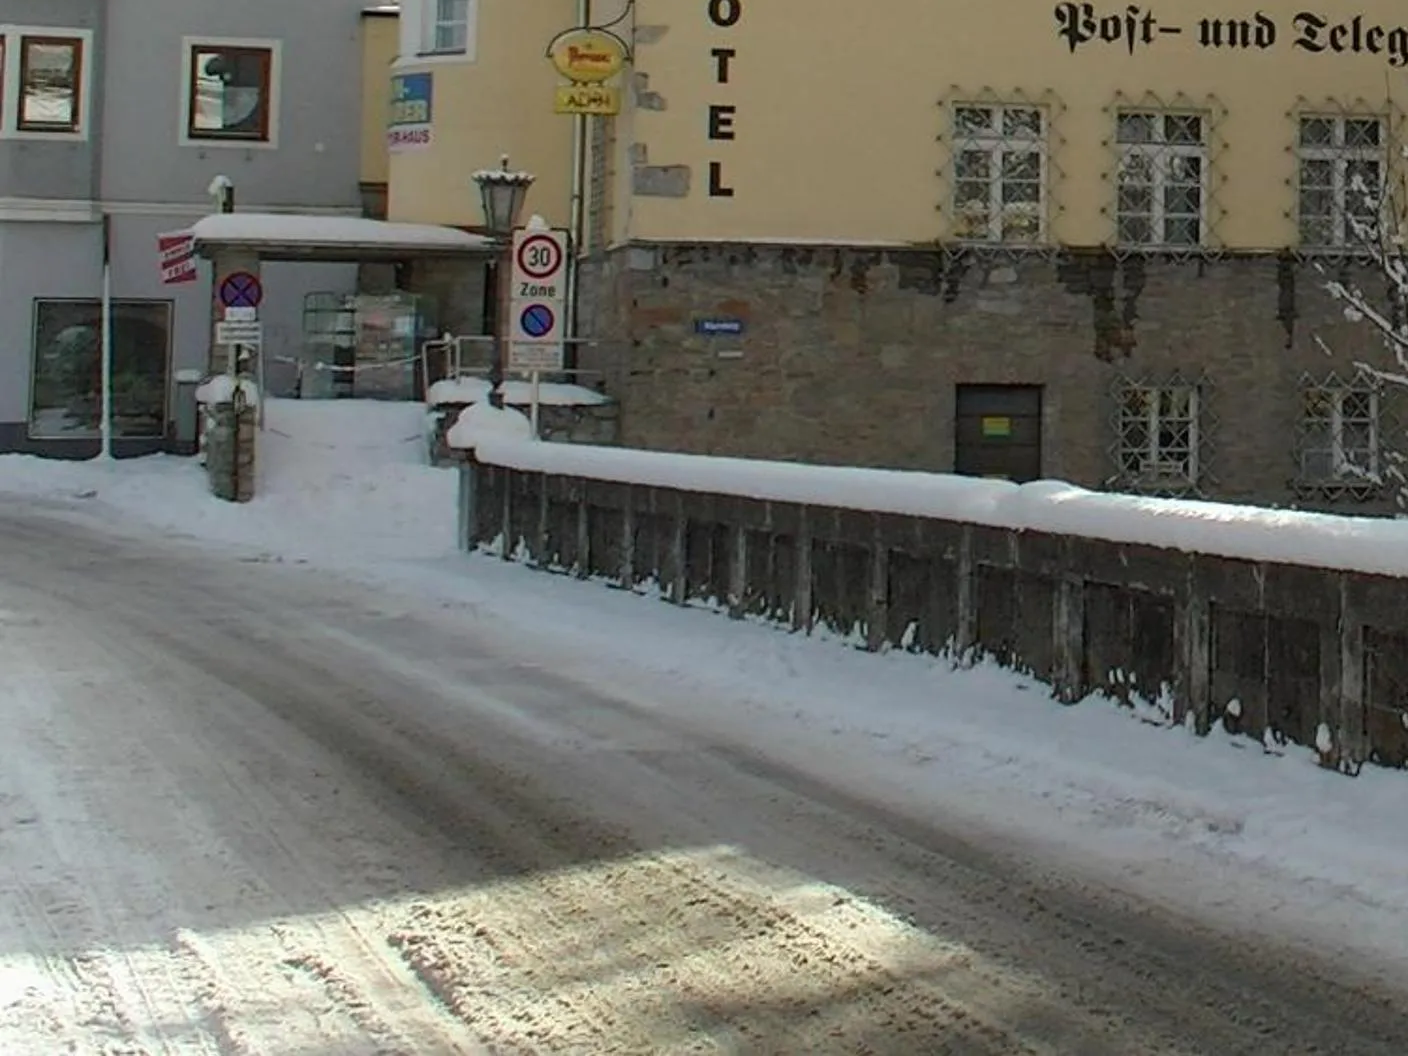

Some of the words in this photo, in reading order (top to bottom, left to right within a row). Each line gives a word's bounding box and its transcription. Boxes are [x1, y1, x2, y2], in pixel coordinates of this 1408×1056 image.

[1198, 10, 1276, 48] und
[528, 246, 551, 266] 30
[520, 282, 556, 297] Zone
